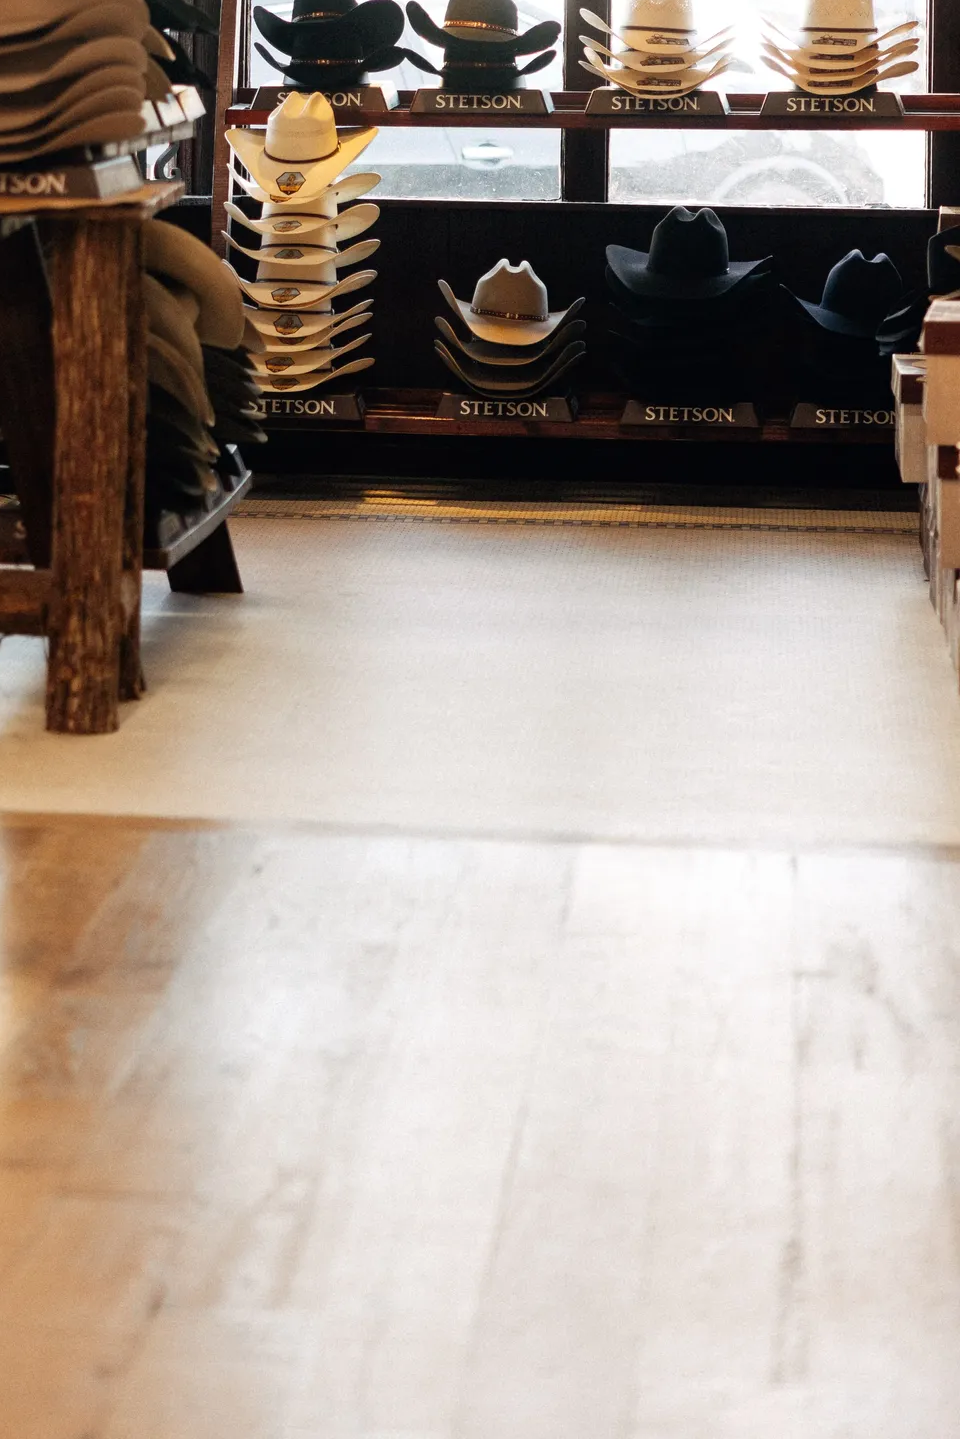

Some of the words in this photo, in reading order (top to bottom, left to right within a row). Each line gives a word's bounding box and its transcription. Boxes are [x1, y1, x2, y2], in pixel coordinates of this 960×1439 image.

[435, 94, 523, 109] STETSON
[611, 95, 700, 110] STETSON
[786, 97, 876, 112] STETSON
[459, 400, 549, 417] STETSON
[645, 406, 735, 423] STETSON
